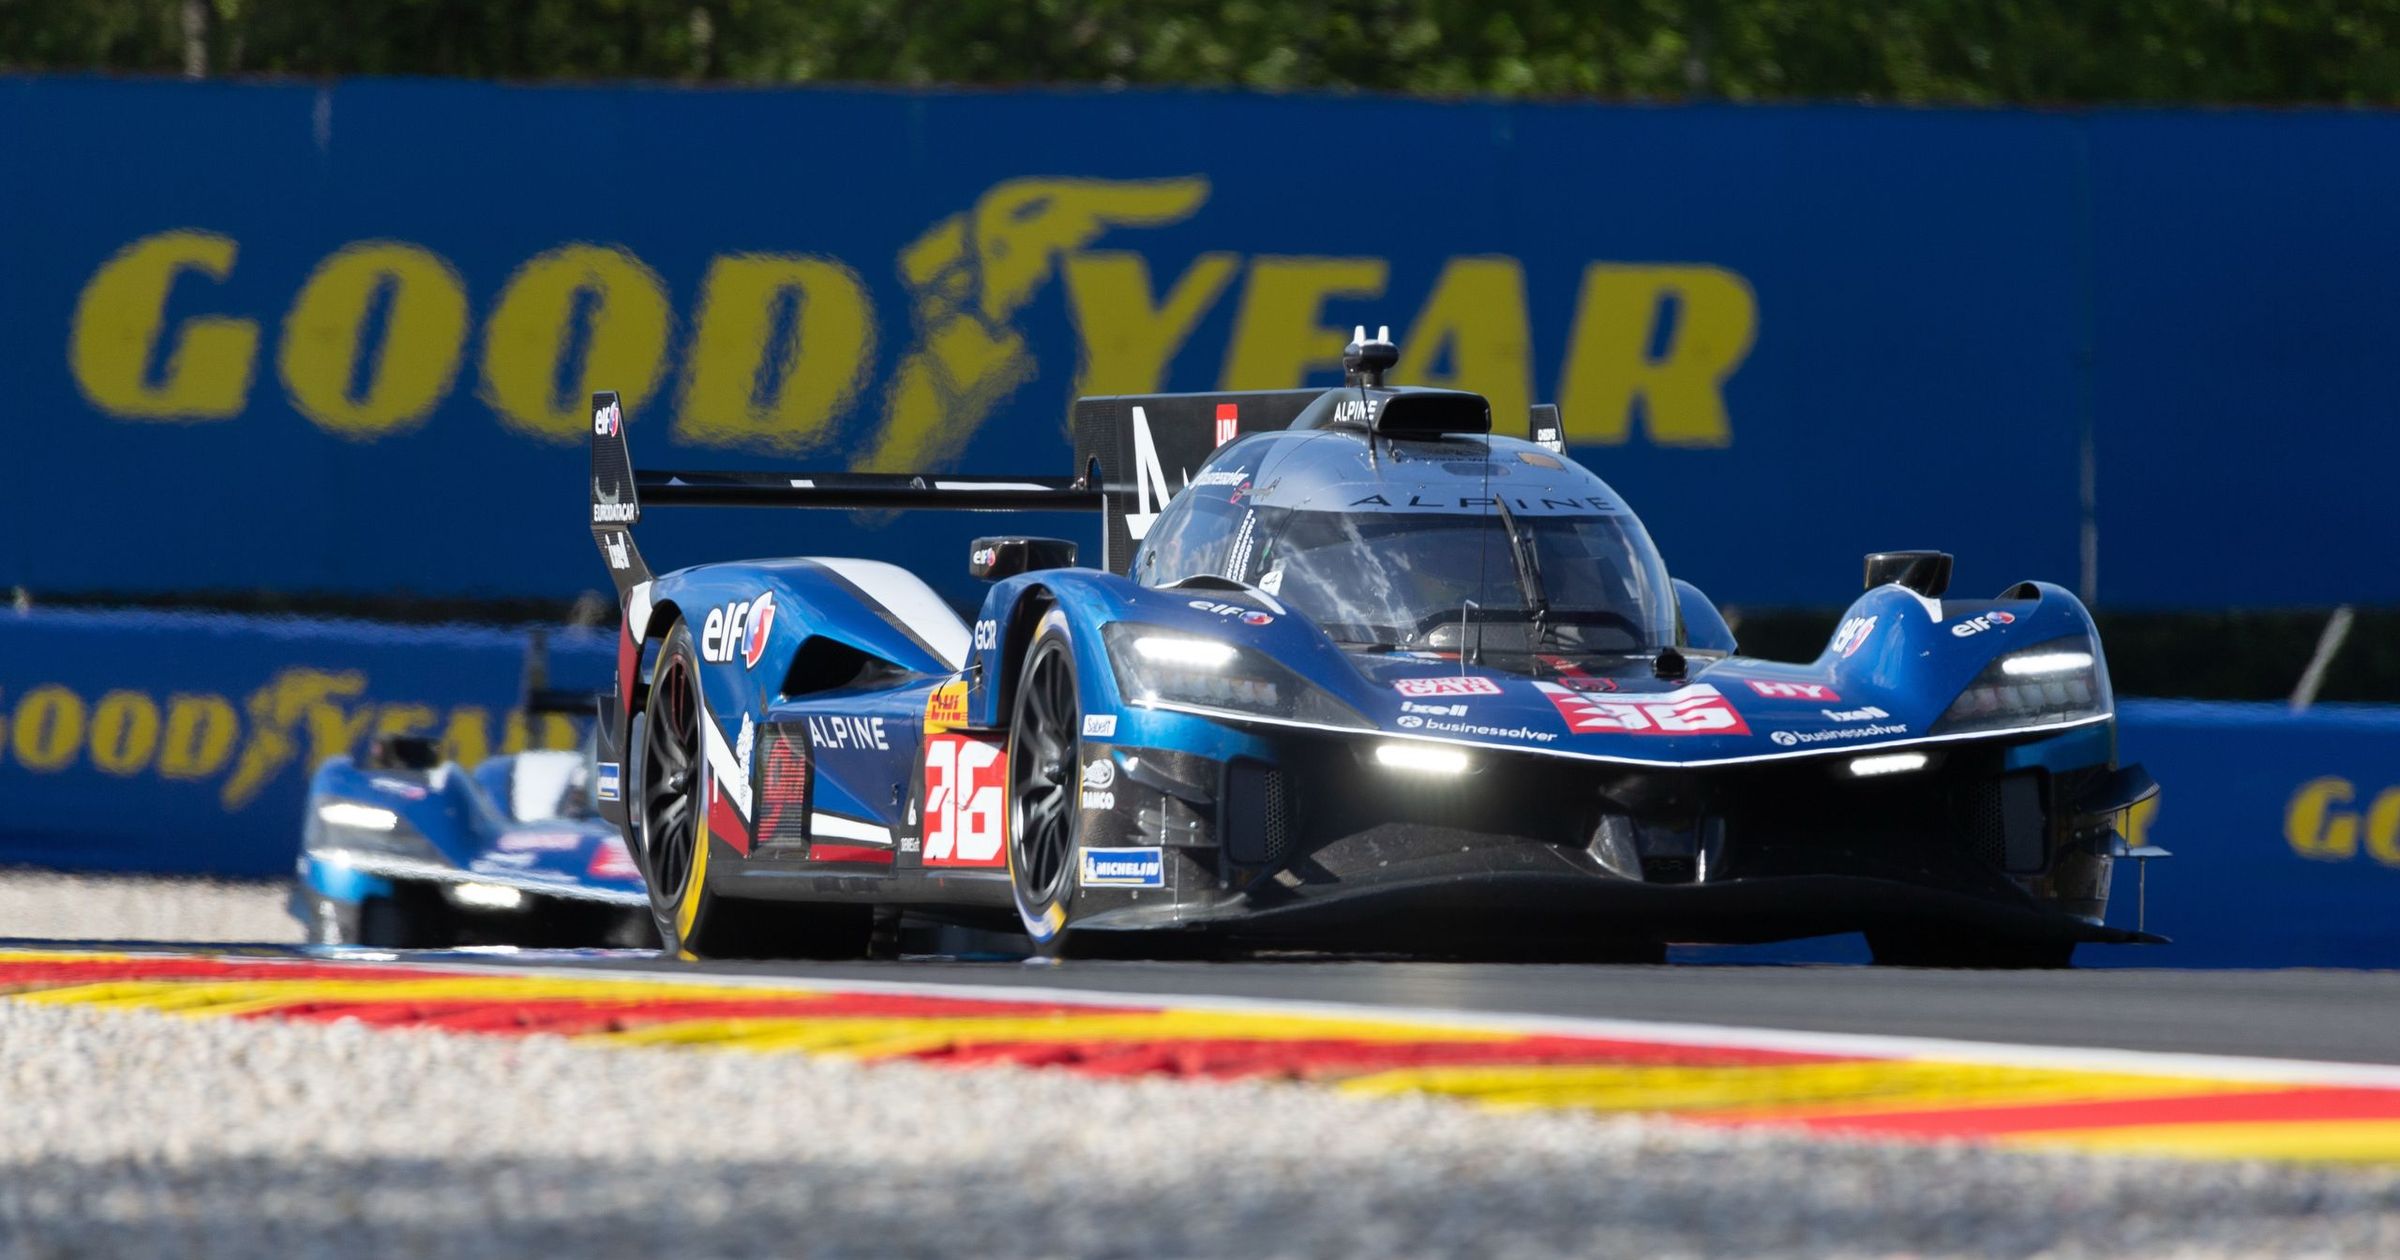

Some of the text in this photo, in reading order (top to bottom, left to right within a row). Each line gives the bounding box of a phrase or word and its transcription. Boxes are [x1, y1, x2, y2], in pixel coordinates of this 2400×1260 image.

[1334, 399, 1378, 422] ALPINE
[1348, 493, 1616, 511] ALPINE
[1188, 600, 1245, 617] elf
[701, 600, 751, 662] elf
[974, 619, 997, 650] GCR
[1951, 616, 1991, 638] elf
[1753, 680, 1825, 698] HY
[931, 694, 961, 721] DHL
[1558, 696, 1738, 731] 36
[0, 683, 239, 779] OOD
[808, 716, 890, 751] ALPINE
[1425, 718, 1558, 742] businessolver
[1797, 723, 1908, 743] businessolver
[922, 740, 1003, 861] 36
[1096, 861, 1160, 876] MICHELIN
